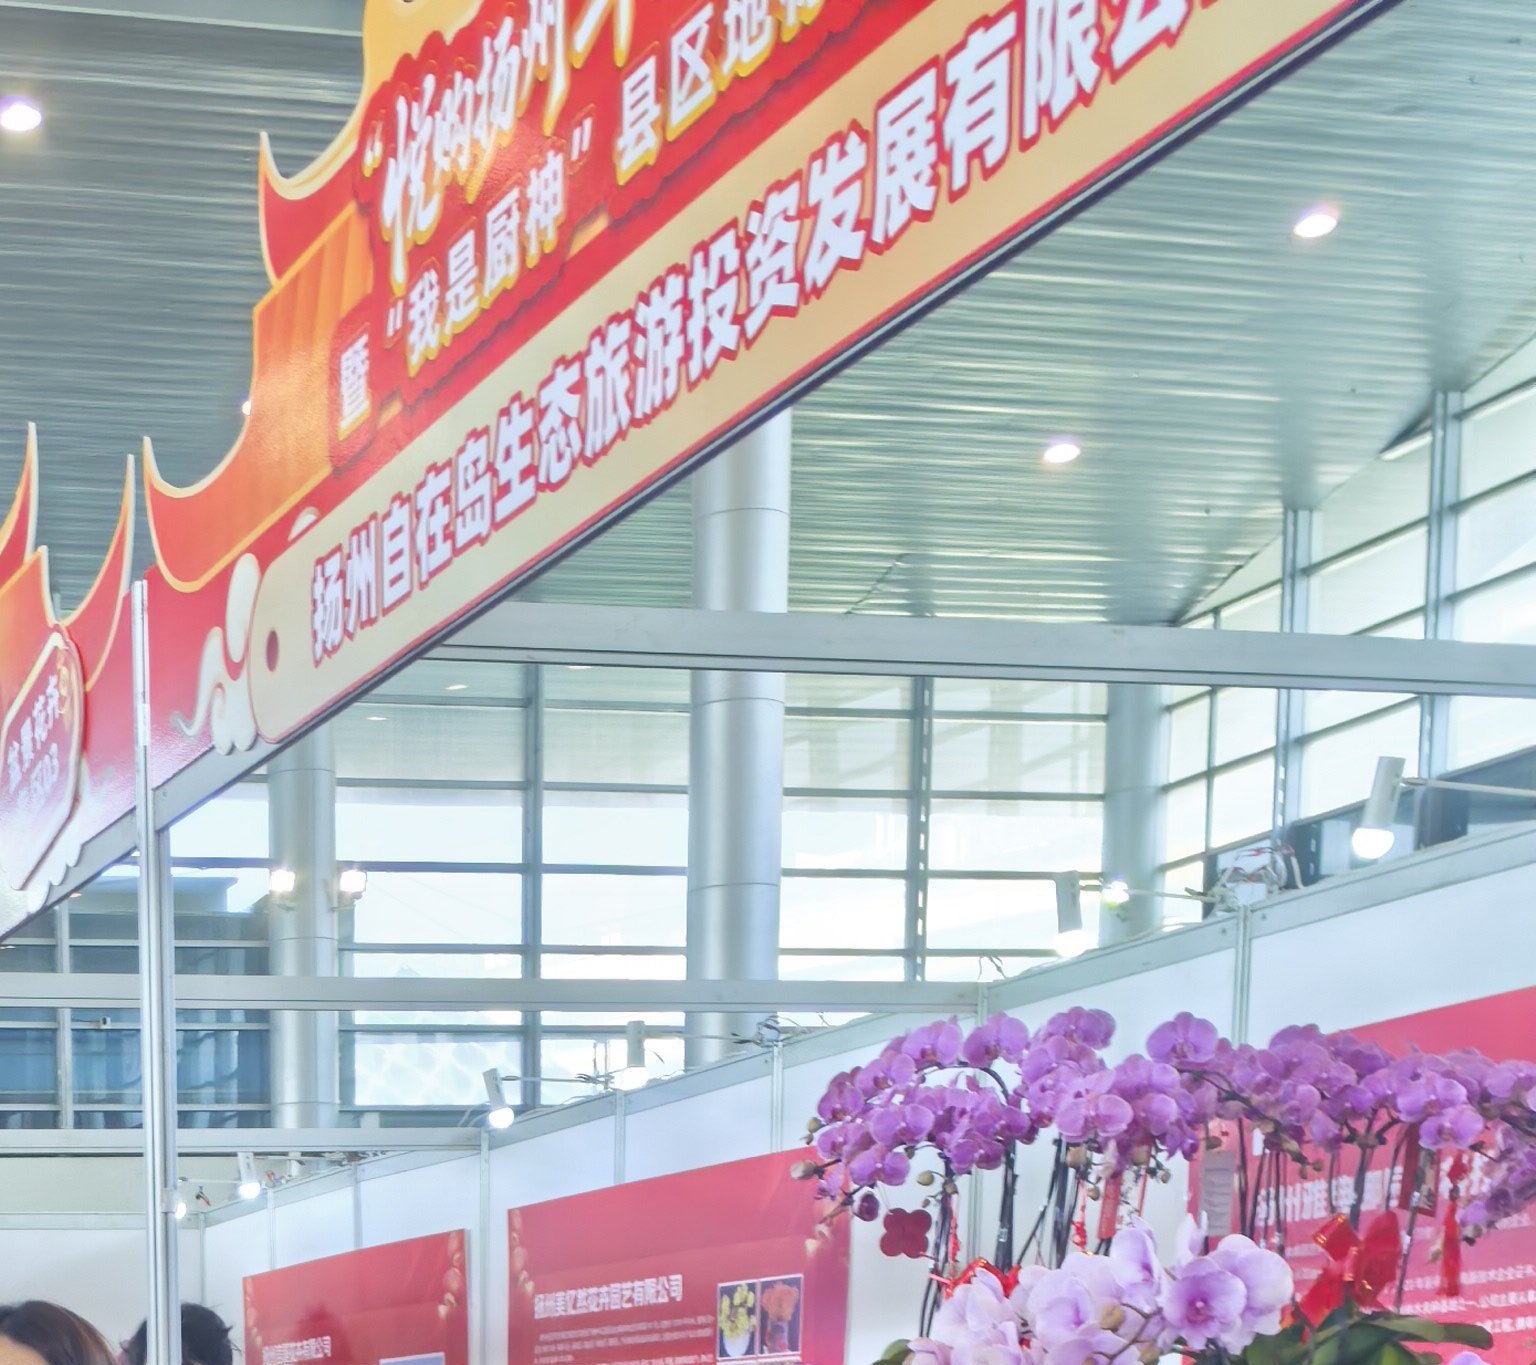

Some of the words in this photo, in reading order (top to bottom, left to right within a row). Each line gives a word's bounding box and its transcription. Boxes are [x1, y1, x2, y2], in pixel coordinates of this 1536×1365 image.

[339, 333, 370, 432] 暨
[616, 0, 826, 180] 县区地
